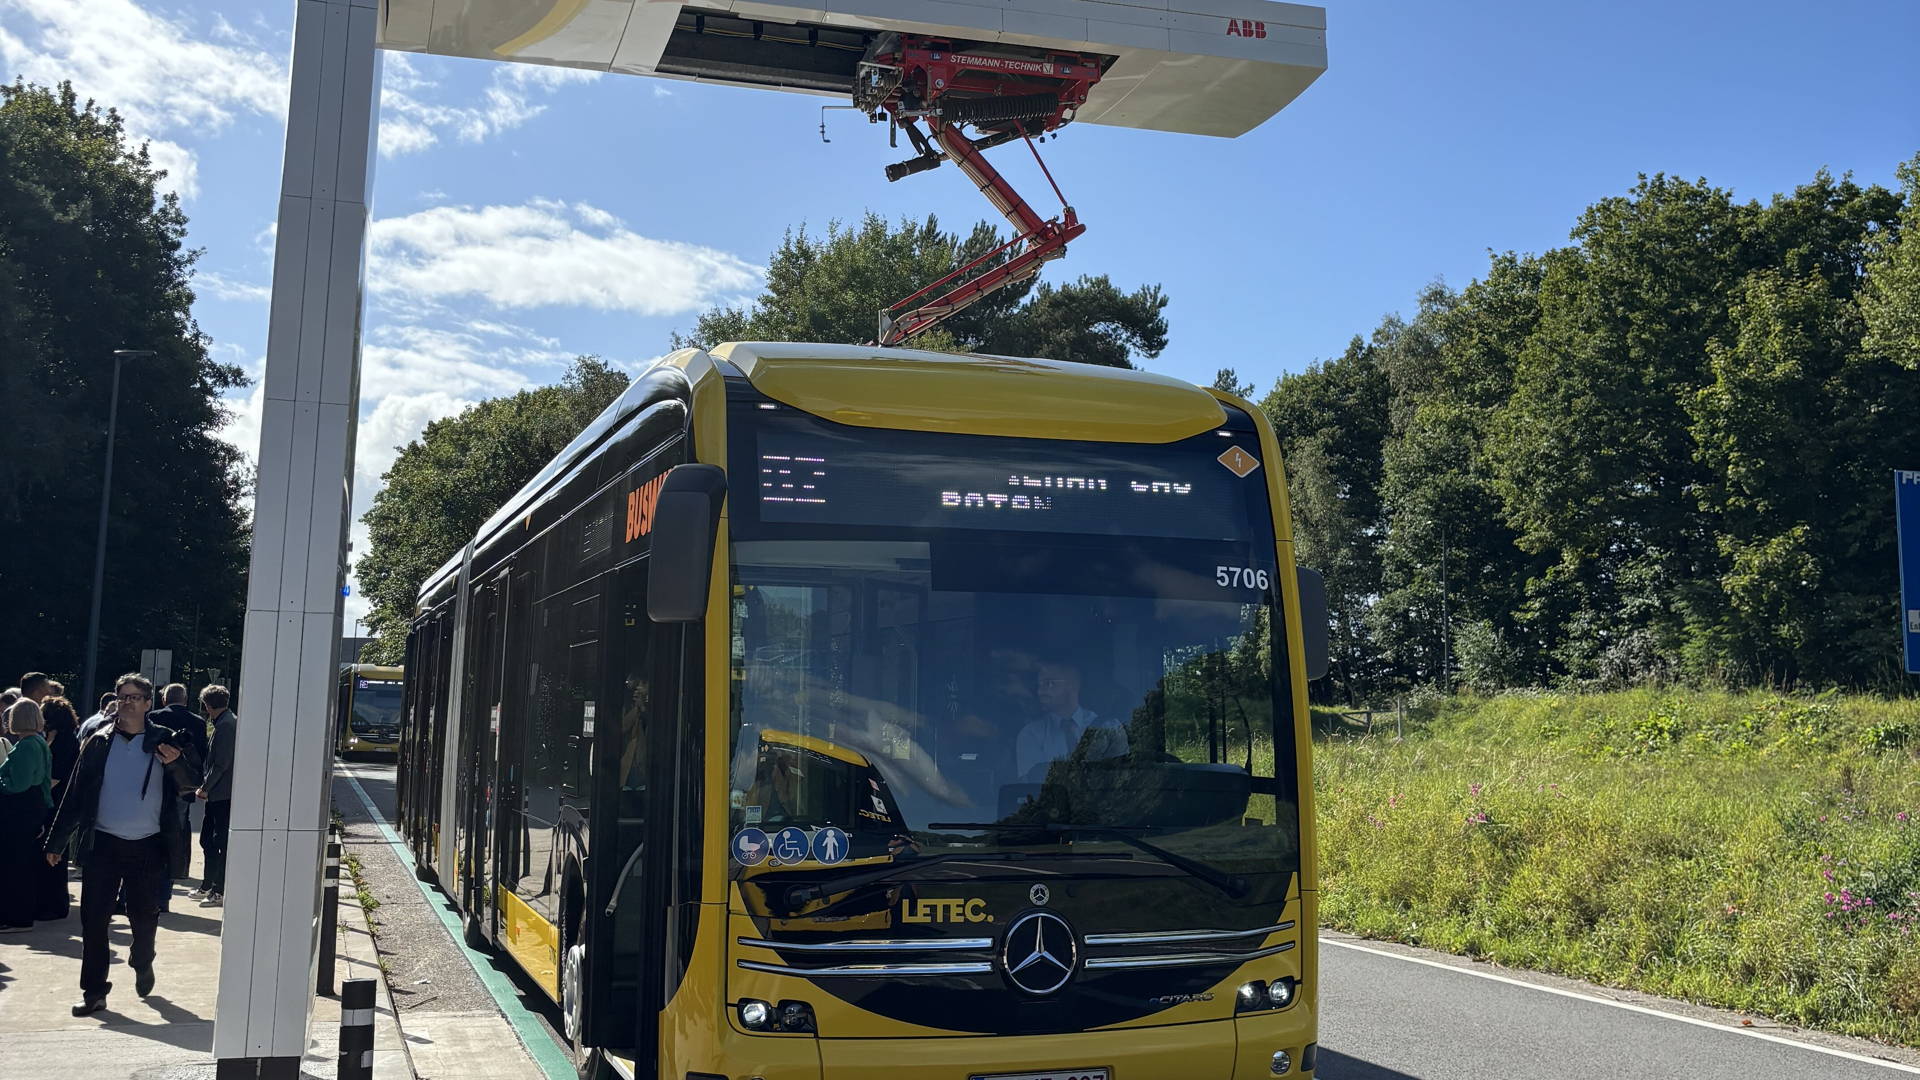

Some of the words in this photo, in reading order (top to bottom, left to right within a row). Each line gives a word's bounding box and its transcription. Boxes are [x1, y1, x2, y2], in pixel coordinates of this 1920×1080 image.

[1226, 18, 1267, 38] ABB
[1216, 565, 1269, 590] 5706
[902, 898, 994, 923] LETEC.
